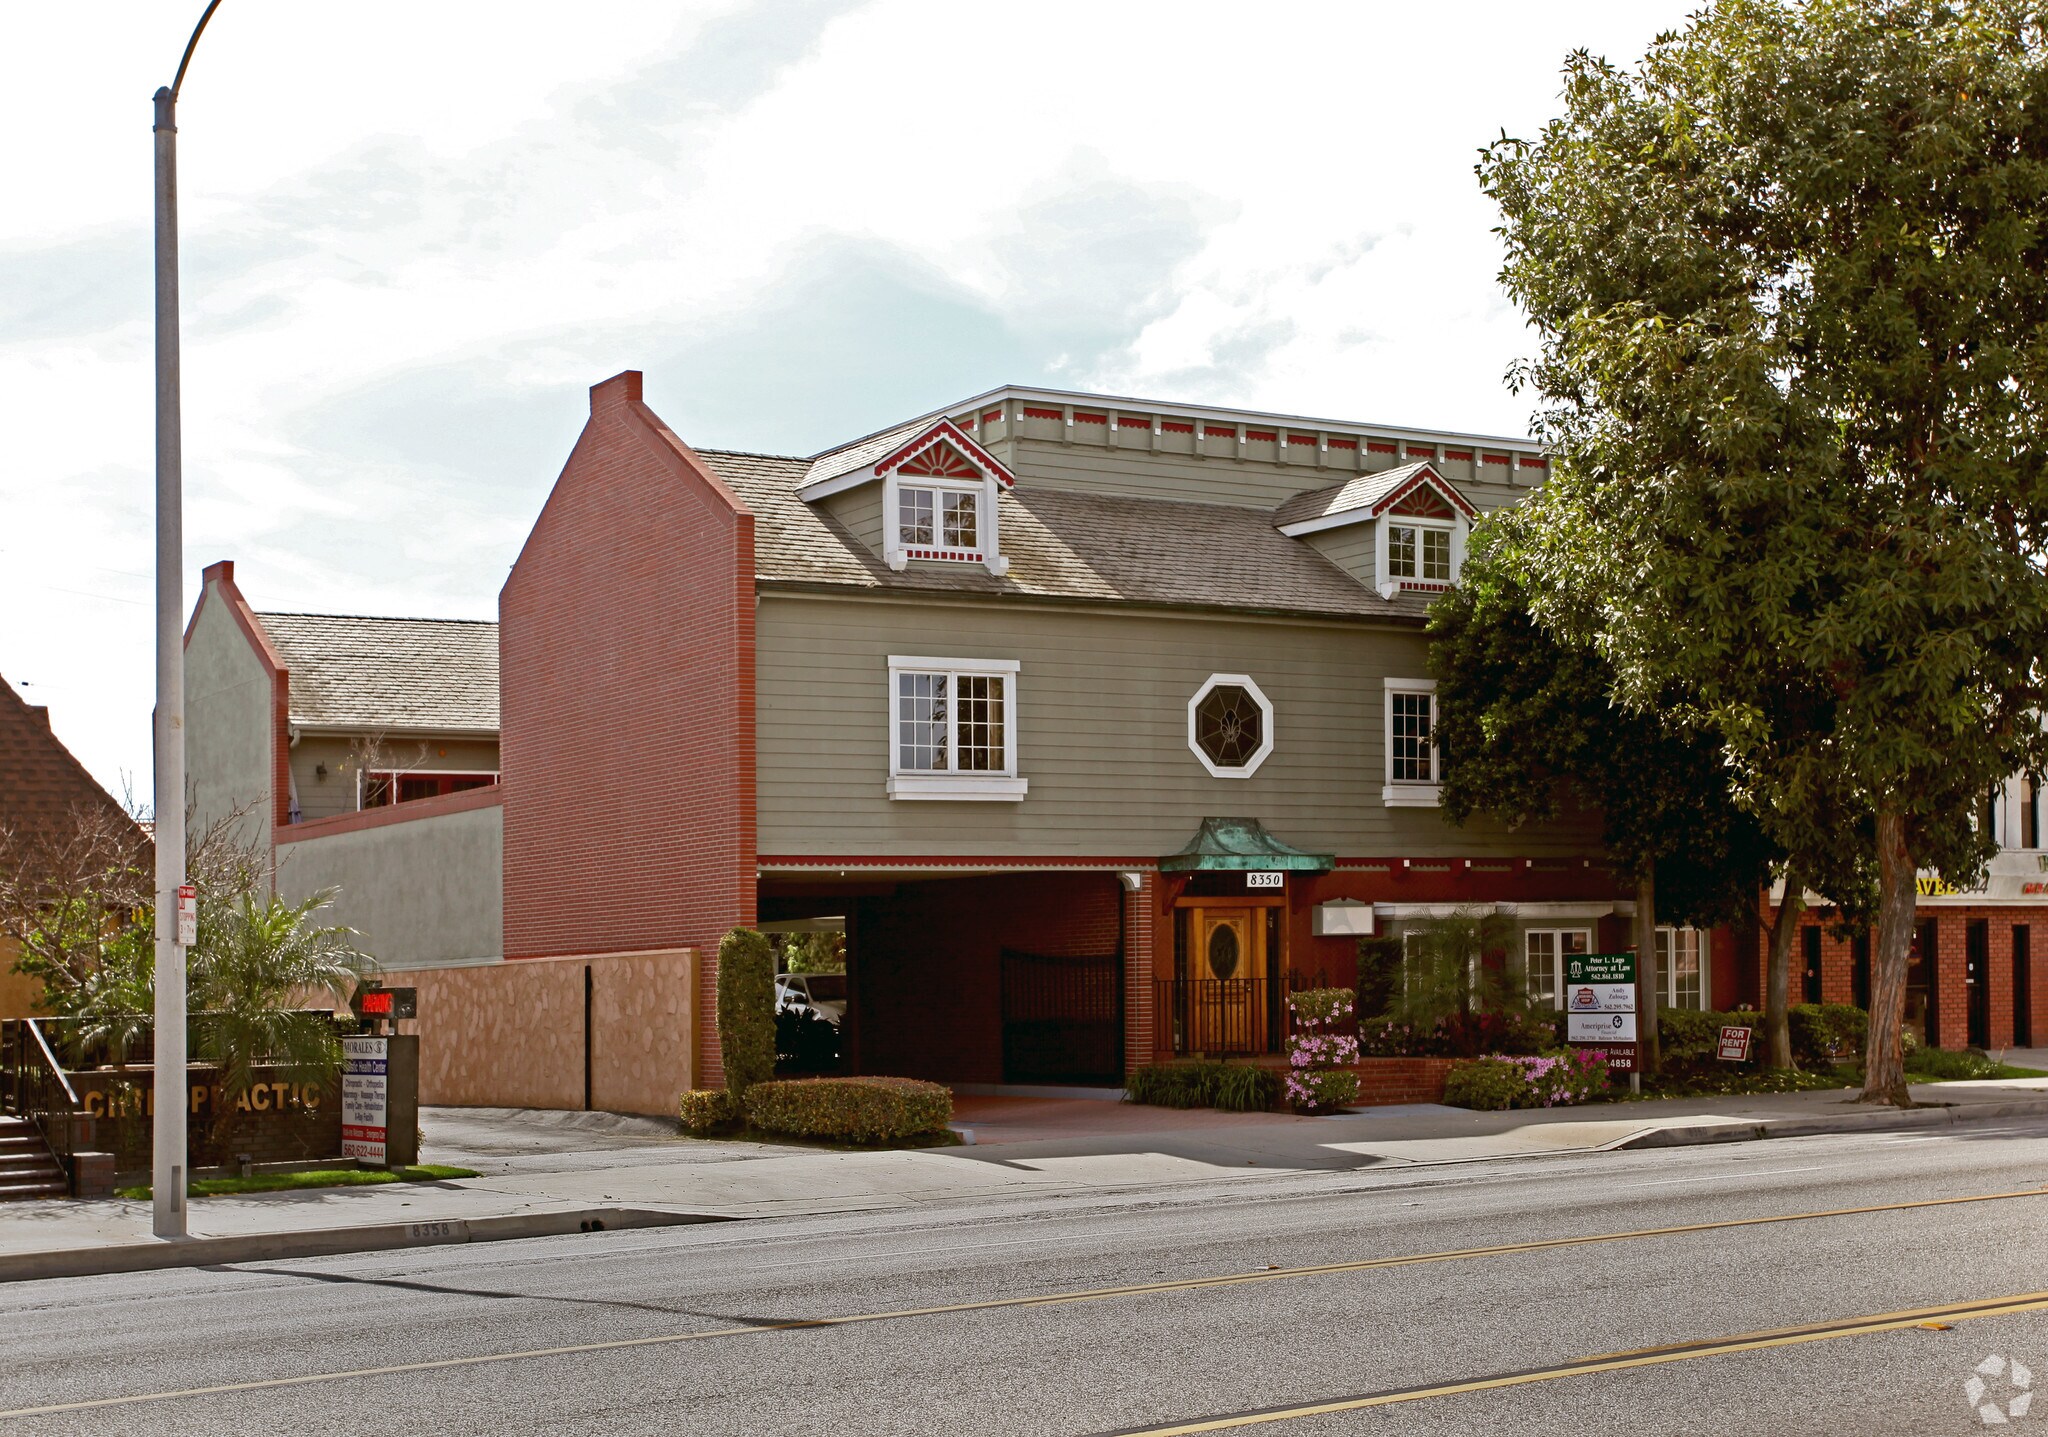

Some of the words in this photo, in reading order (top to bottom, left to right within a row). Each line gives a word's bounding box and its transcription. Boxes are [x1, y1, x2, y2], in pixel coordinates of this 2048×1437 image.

[1250, 874, 1280, 886] 8350
[180, 912, 196, 922] STOPPING
[1611, 956, 1625, 965] Lago
[1584, 965, 1608, 974] Attorney
[1618, 964, 1631, 972] Law
[362, 993, 393, 1013] PARKING
[1580, 1022, 1612, 1031] Ameriprise
[1725, 1029, 1745, 1039] FOR
[344, 1041, 373, 1054] MORALES
[1721, 1038, 1746, 1048] RENT
[1610, 1048, 1635, 1056] AVAILABLE
[359, 1061, 373, 1073] Health
[373, 1060, 387, 1073] Center
[344, 1143, 384, 1159] 562/622-4444
[413, 1222, 449, 1237] 8358
